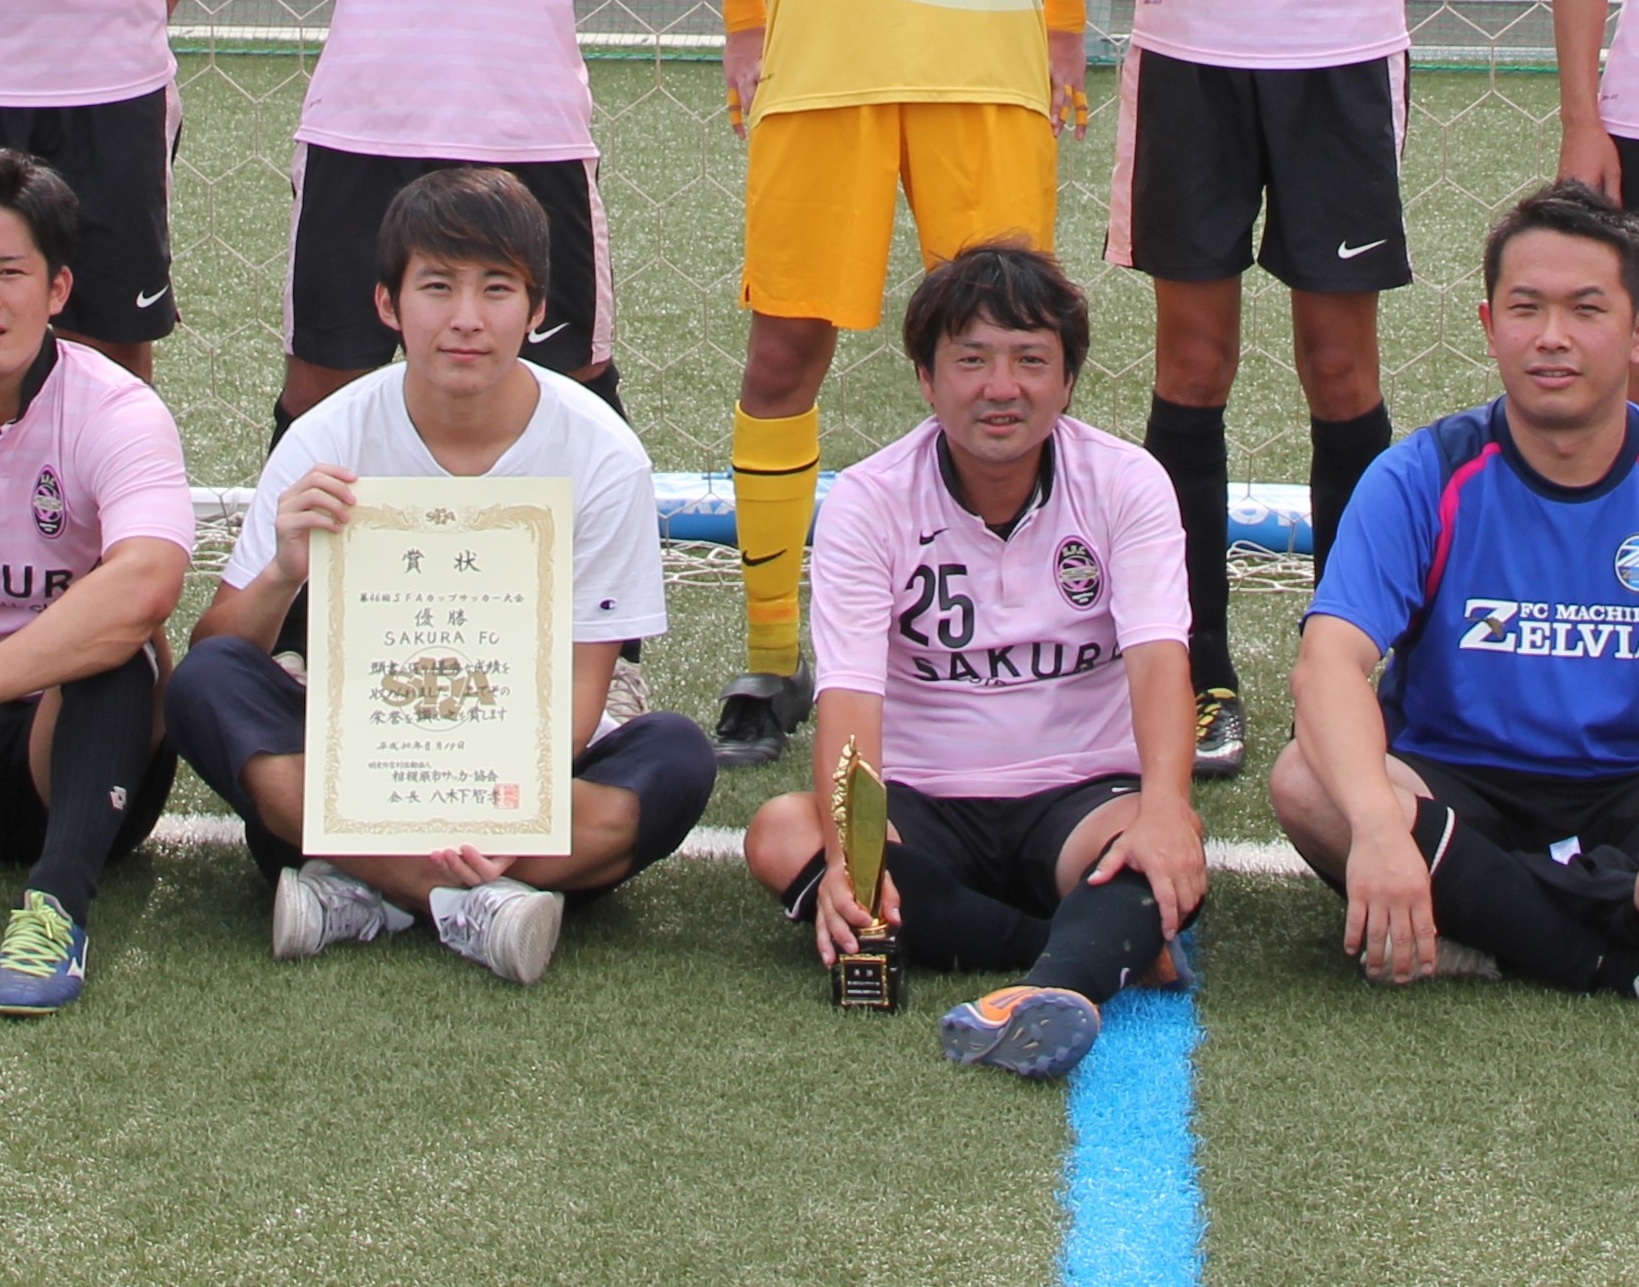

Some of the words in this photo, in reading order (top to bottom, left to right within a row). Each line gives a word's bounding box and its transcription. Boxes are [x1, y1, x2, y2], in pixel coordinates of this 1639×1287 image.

[402, 549, 482, 573] 賞状
[899, 564, 975, 649] 25
[1520, 602, 1548, 619] FC
[414, 608, 468, 628] 優勝
[383, 631, 465, 646] SAKURA
[479, 631, 500, 645] FC
